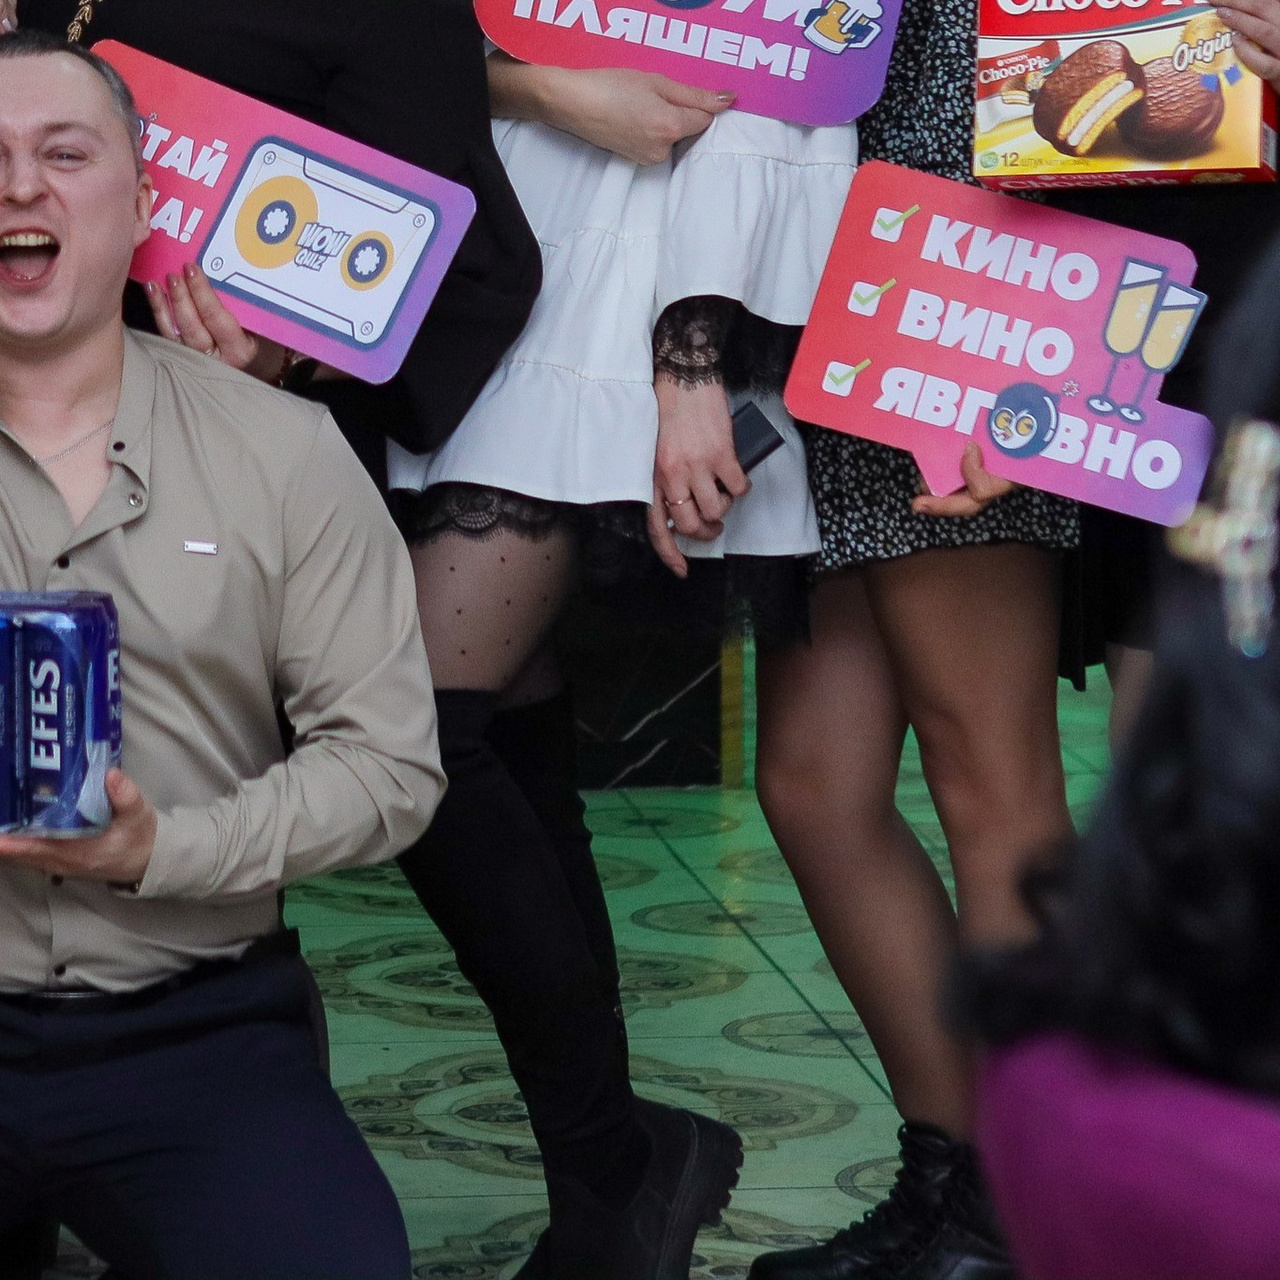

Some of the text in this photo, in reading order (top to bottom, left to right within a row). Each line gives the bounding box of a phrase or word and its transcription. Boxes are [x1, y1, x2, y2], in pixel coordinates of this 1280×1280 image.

[1172, 31, 1234, 72] Origin
[141, 122, 229, 188] ТАЙ
[1001, 152, 1019, 167] 12
[149, 189, 204, 244] А!
[297, 222, 352, 258] WOW
[293, 250, 327, 271] QUIZ
[921, 213, 1100, 302] КИНО
[896, 288, 1075, 377] ВИНО
[874, 365, 1183, 491] ЯВГВНО
[29, 658, 61, 771] EFES
